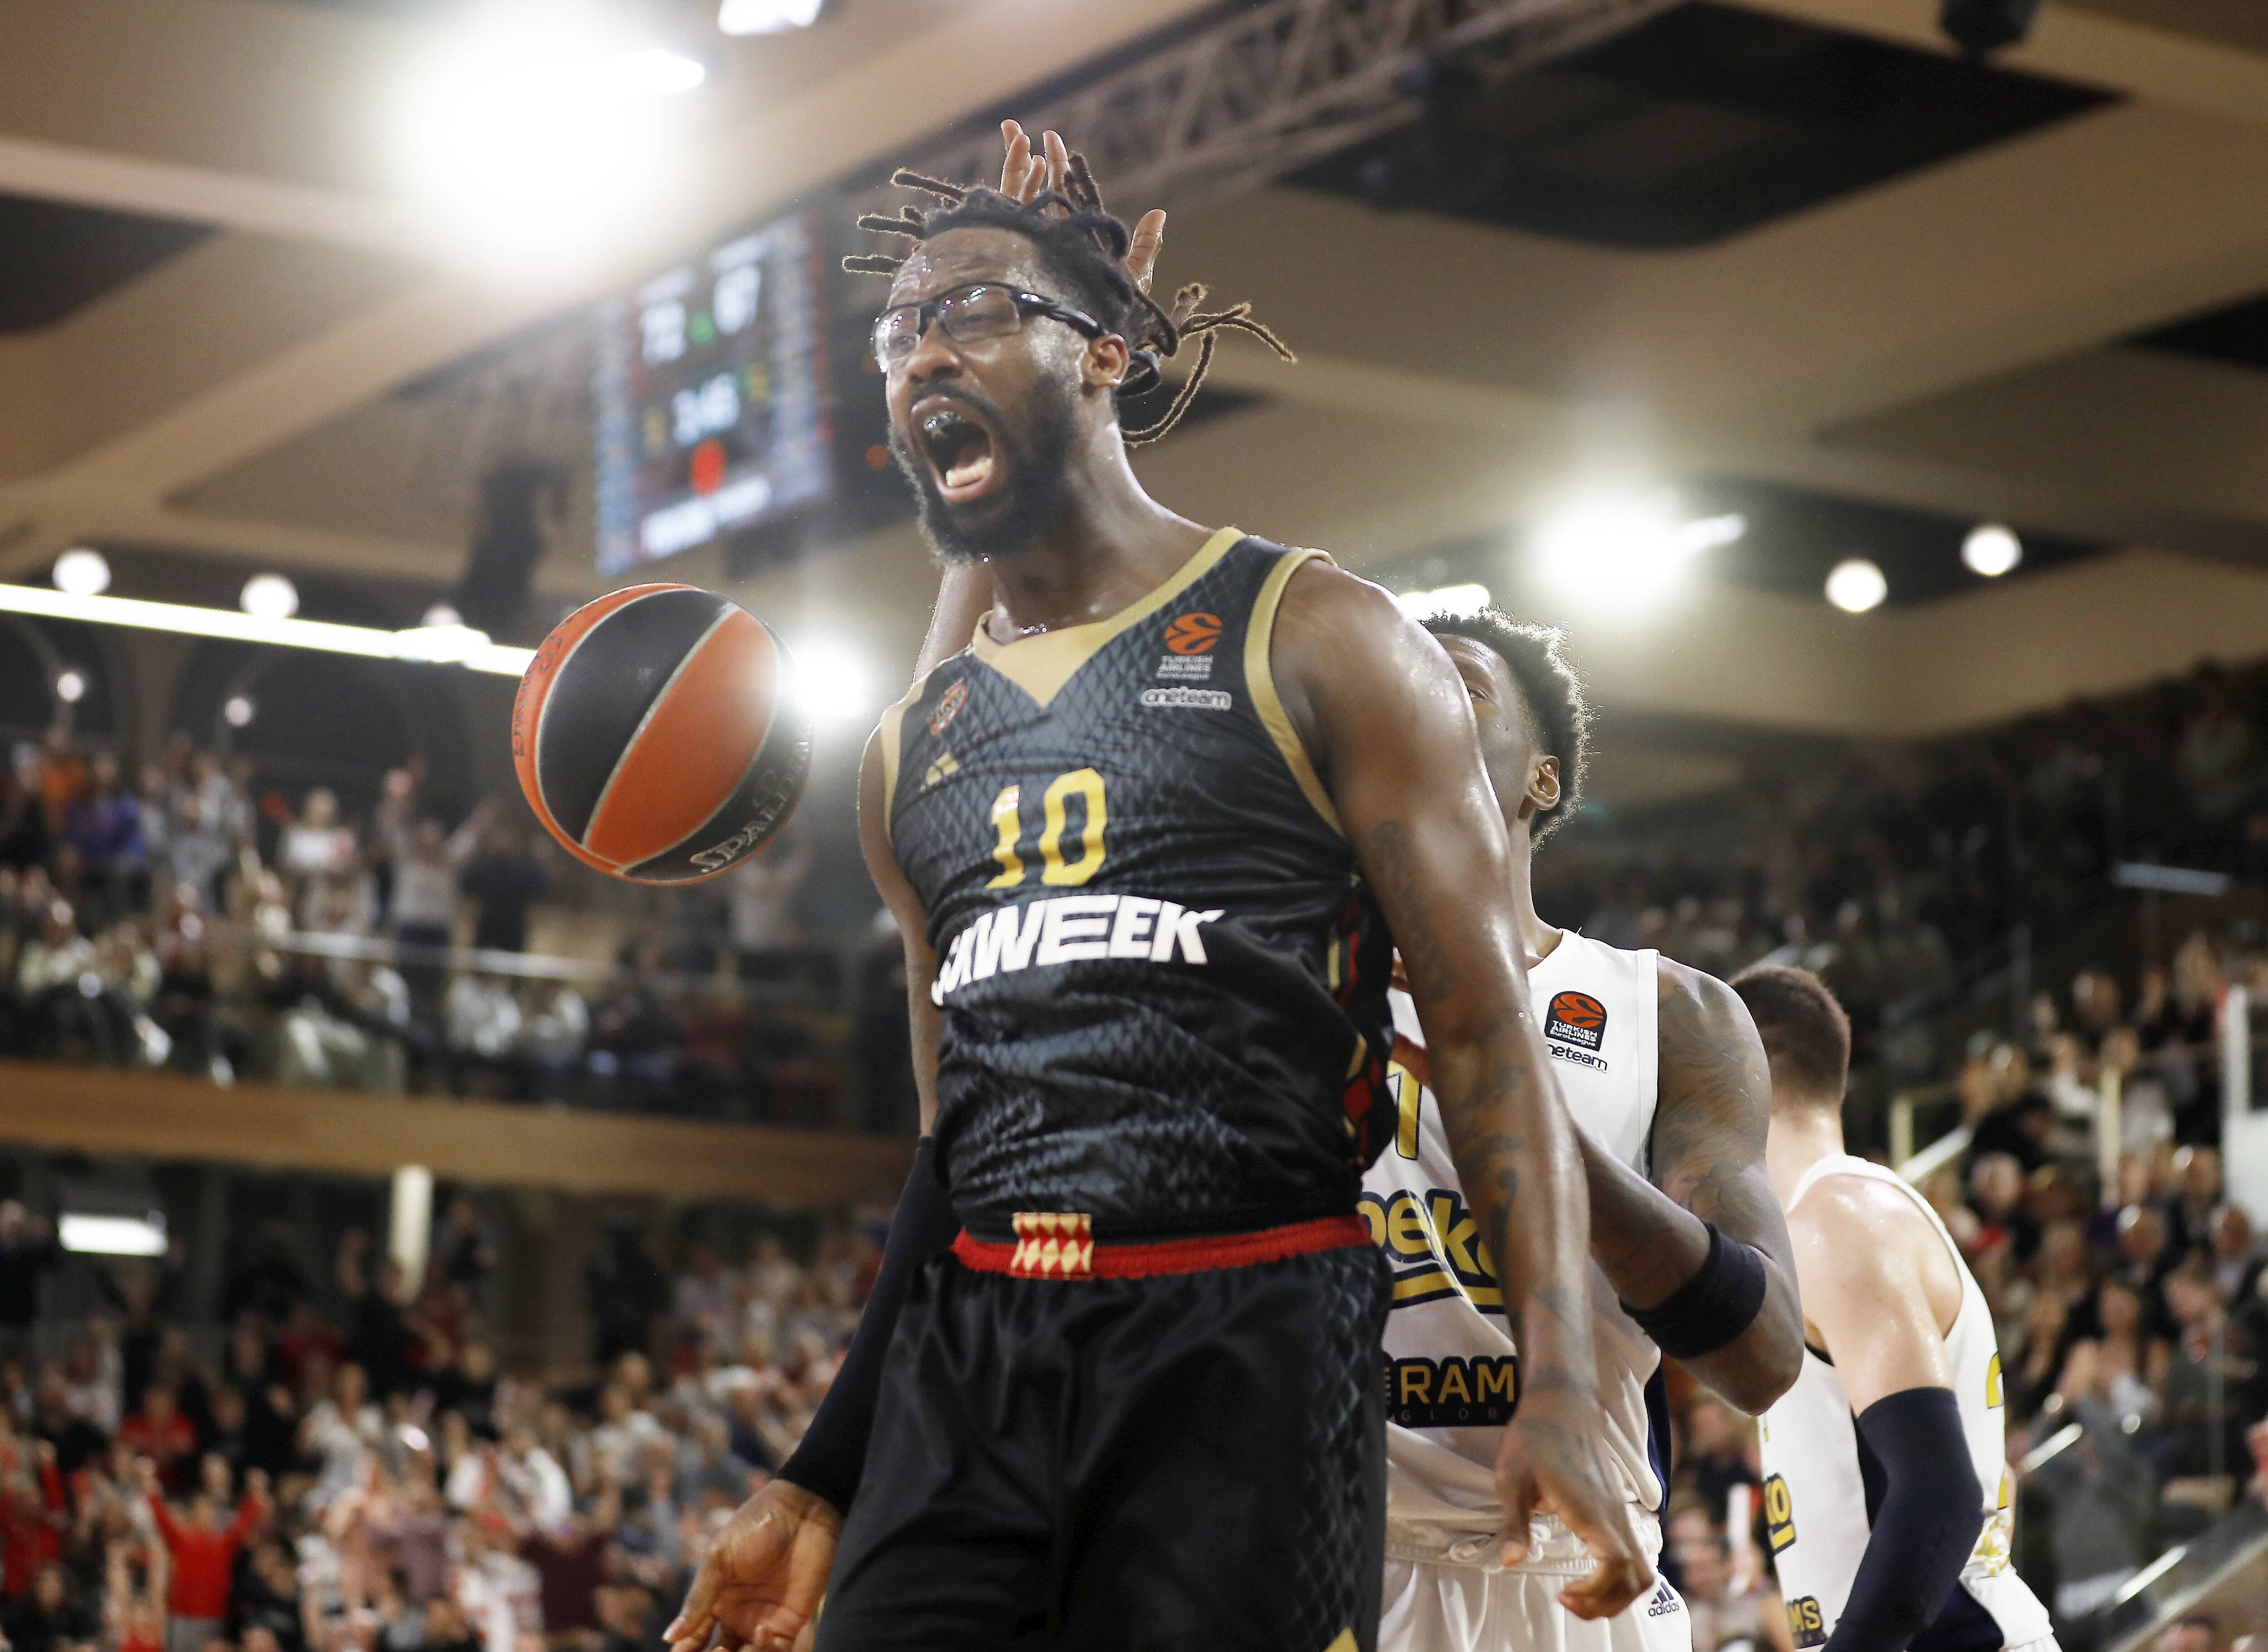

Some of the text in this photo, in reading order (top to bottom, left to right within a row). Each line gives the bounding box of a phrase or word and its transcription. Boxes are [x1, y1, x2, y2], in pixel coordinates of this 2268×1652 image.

[986, 767, 1107, 889] 10
[1551, 1025, 1597, 1042] AIRLINES
[1552, 1020, 1598, 1037] TURKISH
[1549, 1029, 1596, 1047] EuroLeague
[1383, 1363, 1515, 1404] RAM
[1648, 1600, 1680, 1617] adidas
